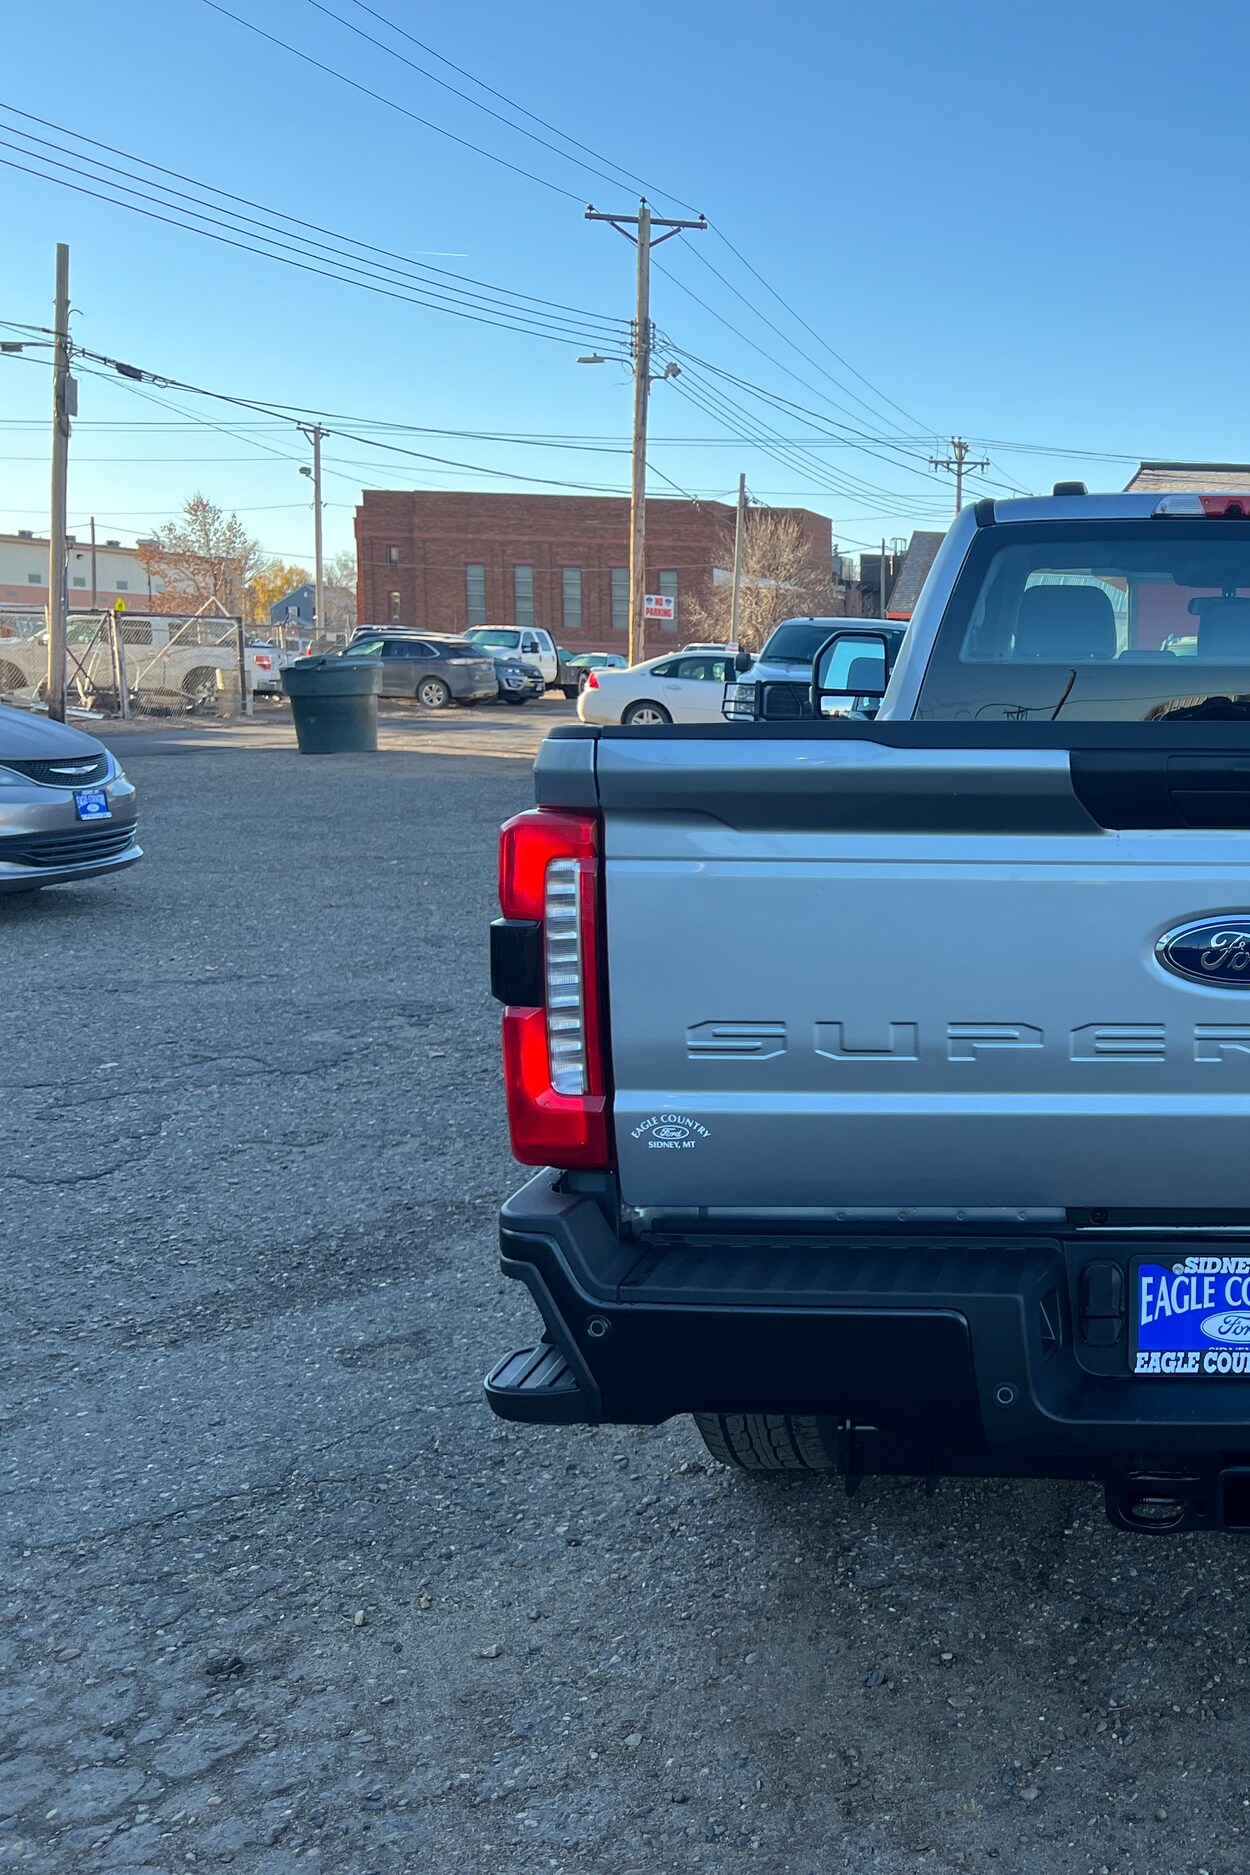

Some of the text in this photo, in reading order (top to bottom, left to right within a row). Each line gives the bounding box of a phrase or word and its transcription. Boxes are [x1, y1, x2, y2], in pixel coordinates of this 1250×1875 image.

[655, 597, 664, 606] NO
[645, 607, 673, 617] PARKING
[630, 1114, 712, 1139] EAGLE COUNTRY
[659, 1127, 683, 1138] Ford
[647, 1140, 696, 1149] SIDNEY, MT
[1140, 1276, 1215, 1326] EAGLE
[1134, 1352, 1200, 1374] EAGLE
